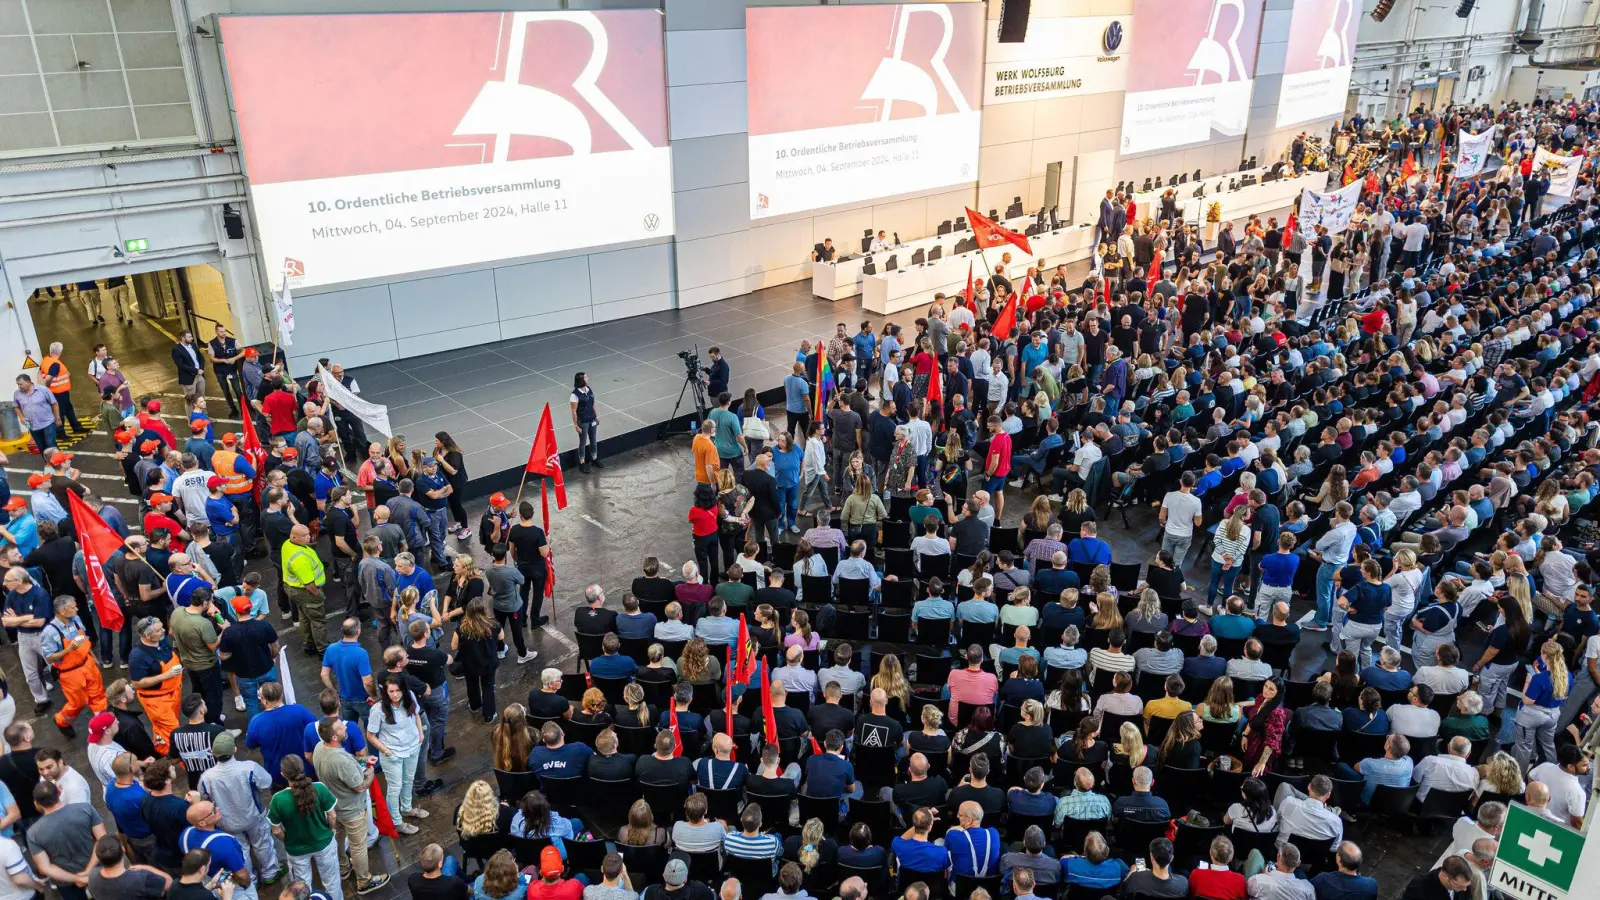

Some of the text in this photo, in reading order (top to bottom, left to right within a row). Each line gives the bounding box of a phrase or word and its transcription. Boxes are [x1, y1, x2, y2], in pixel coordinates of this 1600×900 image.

[996, 66, 1064, 81] WERK WOLFSBURG
[994, 79, 1081, 96] BETRIEBSVERSAMMLUNG
[775, 134, 917, 159] 10. Ordentliche Betriebsversammlung
[775, 167, 814, 179] Mittwoch,
[830, 158, 870, 172] September
[892, 152, 909, 163] Halle
[308, 178, 561, 213] 10. Ordentliche Betriebsversammlung
[312, 198, 568, 240] Mittwoch, 04. September 2024, Halle 11
[542, 760, 566, 770] SVEN
